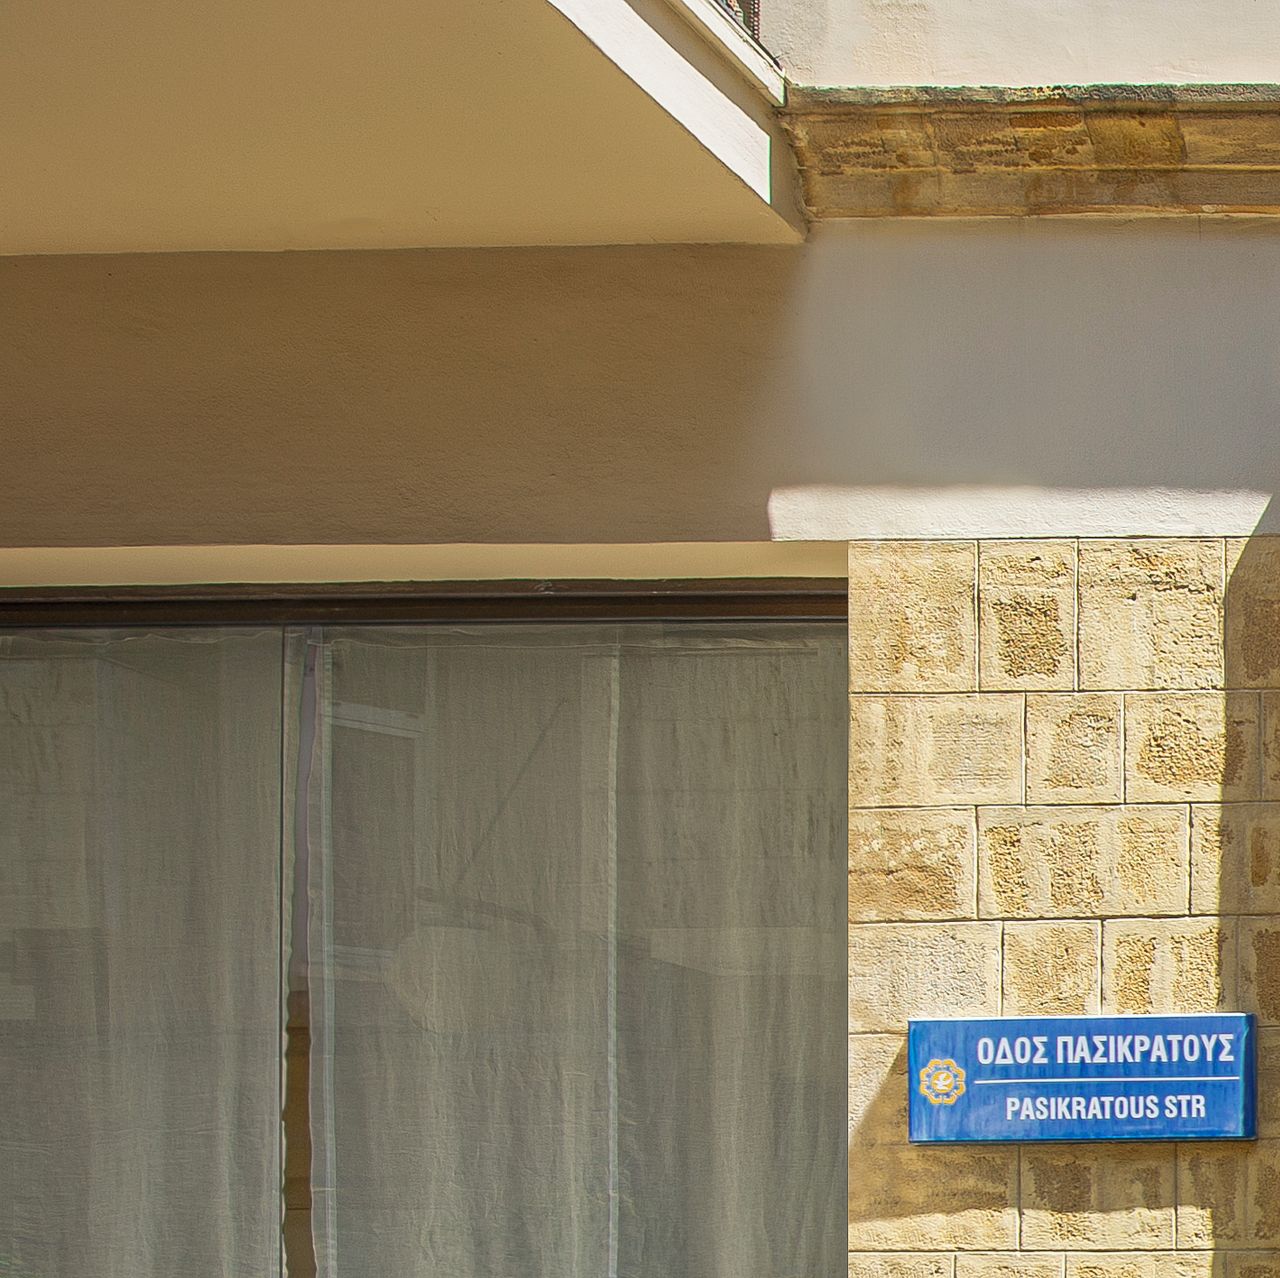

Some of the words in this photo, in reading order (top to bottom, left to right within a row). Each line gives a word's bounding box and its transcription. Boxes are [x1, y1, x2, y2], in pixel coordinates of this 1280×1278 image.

[977, 1036, 1049, 1065] ΟΔΟΣ
[1056, 1033, 1234, 1063] ΠΑΣΙΚΡΑΤΟΥΣ
[1006, 1095, 1159, 1120] PASIKRATOUS
[1164, 1095, 1206, 1118] STR
